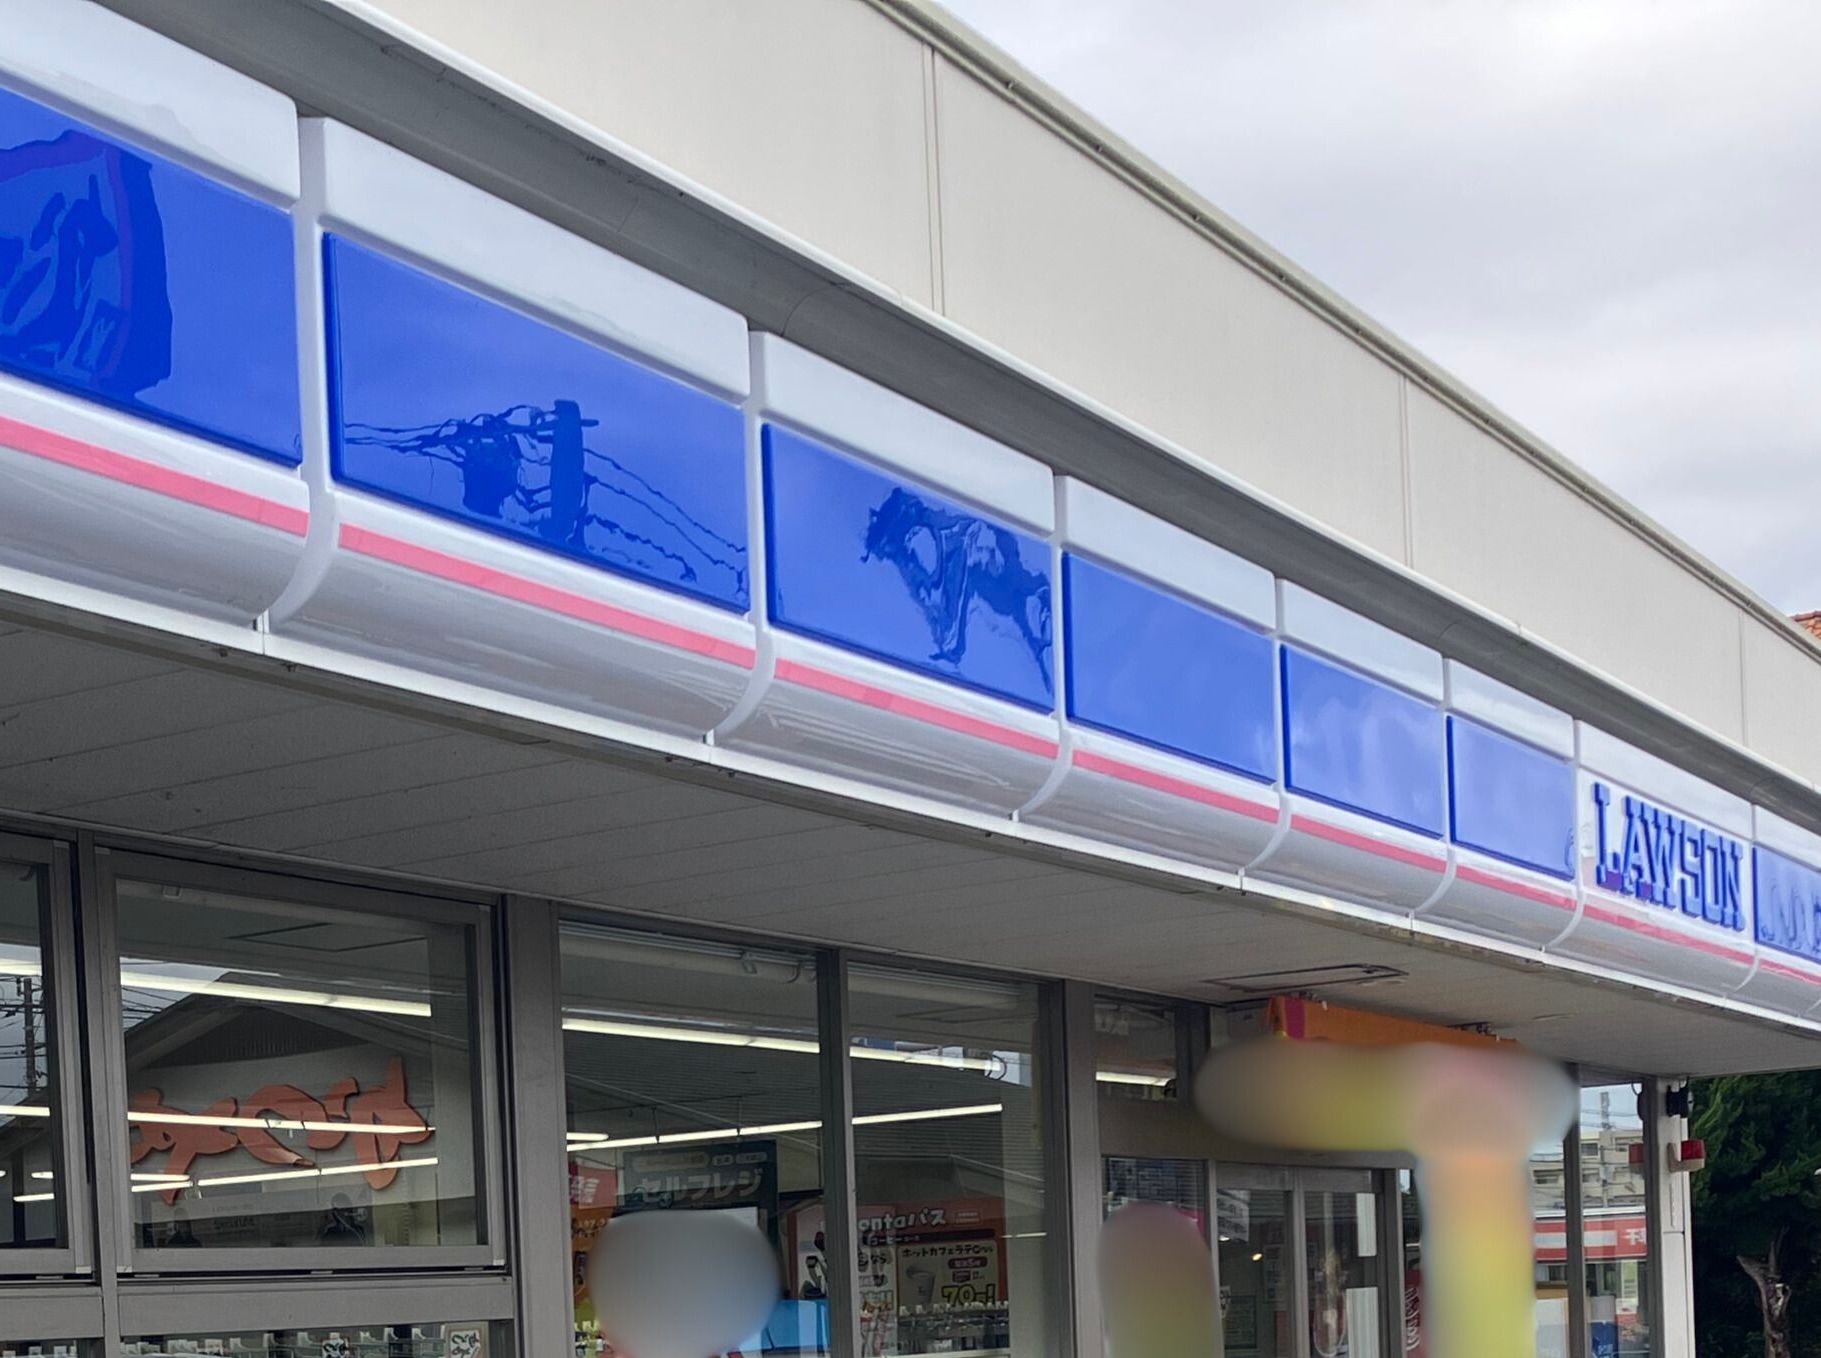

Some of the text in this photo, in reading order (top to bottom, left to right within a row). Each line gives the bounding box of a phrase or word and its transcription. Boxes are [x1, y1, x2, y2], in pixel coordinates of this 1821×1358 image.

[1592, 781, 1746, 932] LAWSON
[641, 1168, 763, 1203] セルフレジ
[858, 1208, 947, 1232] ontaパス
